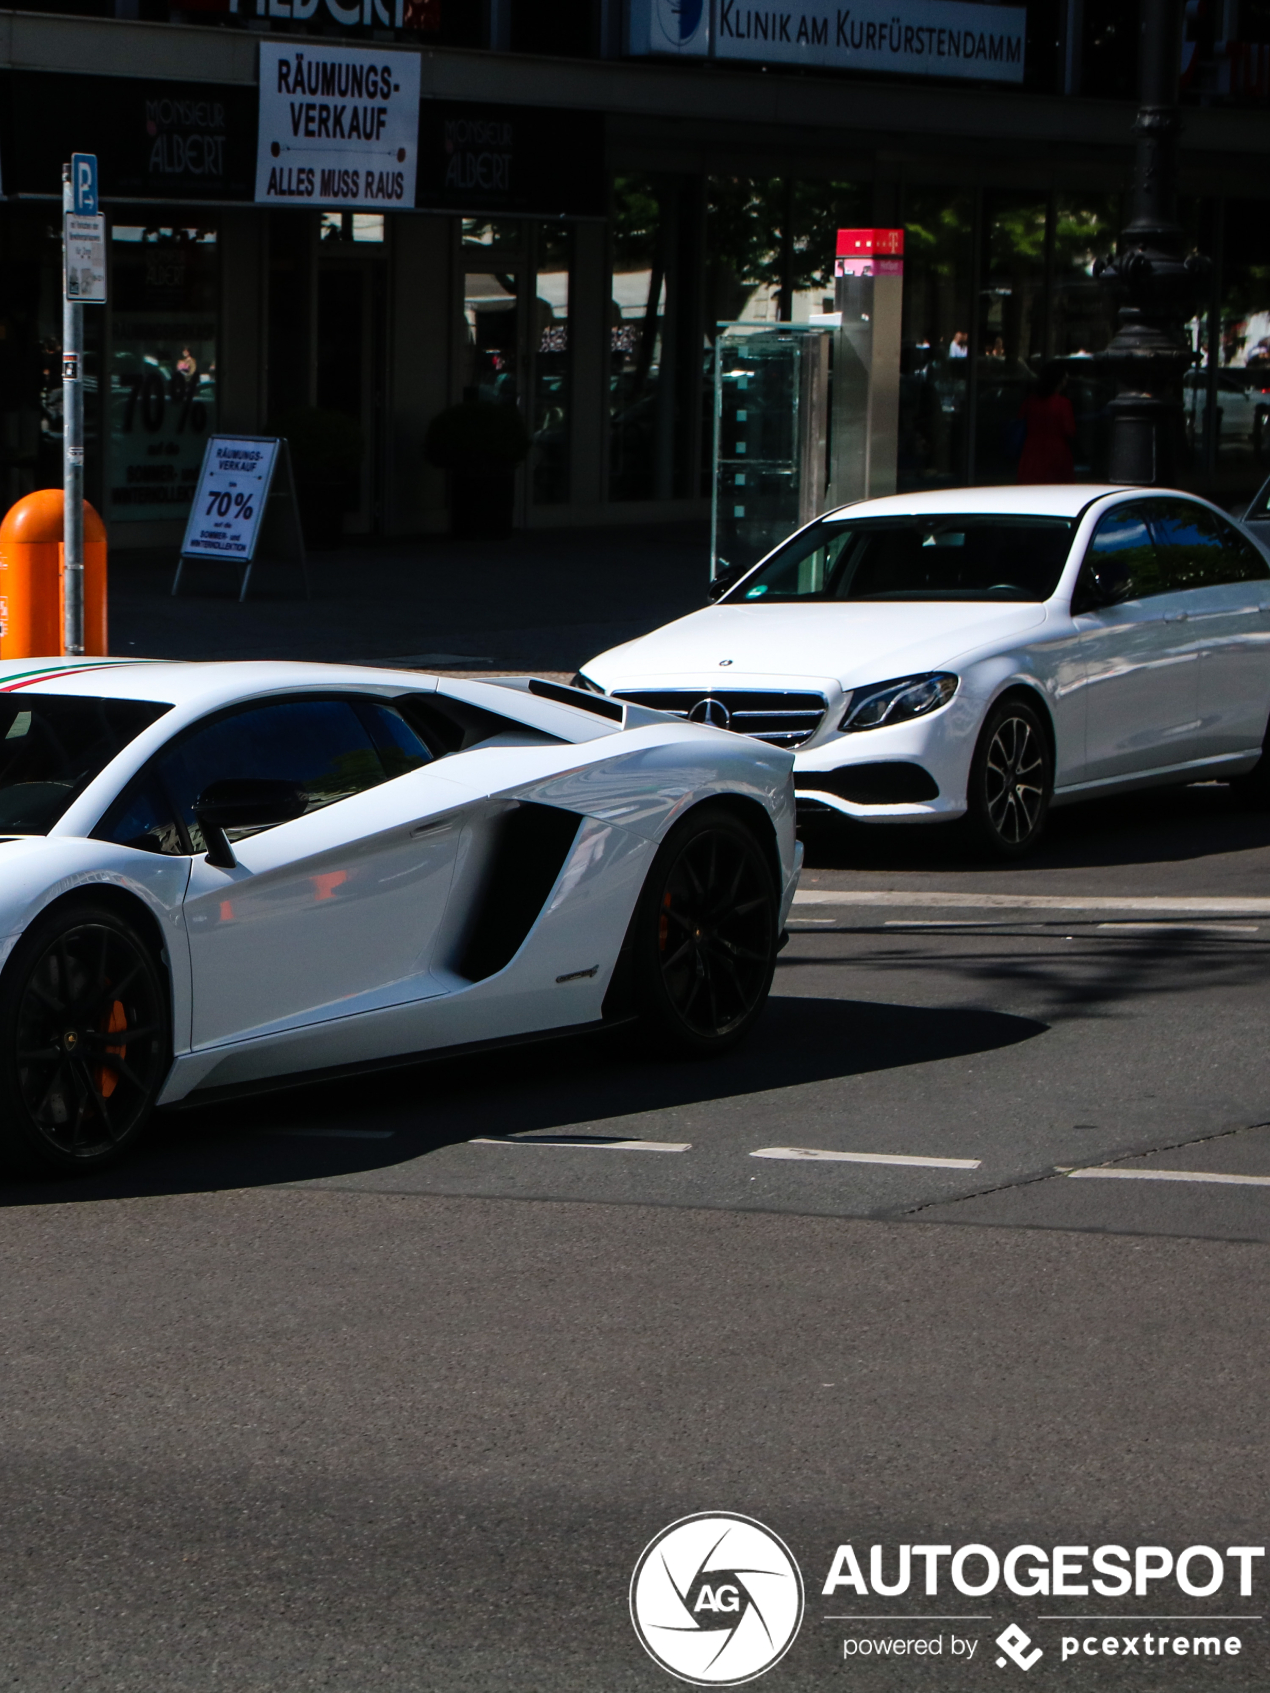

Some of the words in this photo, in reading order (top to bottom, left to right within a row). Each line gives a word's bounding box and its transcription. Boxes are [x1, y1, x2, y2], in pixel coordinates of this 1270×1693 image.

[720, 0, 791, 42] KLINIK
[797, 15, 828, 46] AM
[836, 9, 1022, 63] KURFÜRSTENDAMM
[277, 53, 400, 100] RÄUMUNGS-
[145, 98, 225, 128] MONSIEUR
[289, 102, 388, 141] VERKAUF
[444, 118, 513, 146] MONSIEUR
[148, 133, 226, 176] ALBERT
[444, 152, 513, 191] ALBERT
[267, 167, 315, 197] ALLES
[320, 169, 360, 198] MUSS
[364, 171, 404, 200] RAUS
[120, 371, 207, 433] 70%
[219, 460, 257, 472] VERKAUF
[206, 491, 254, 520] 70%
